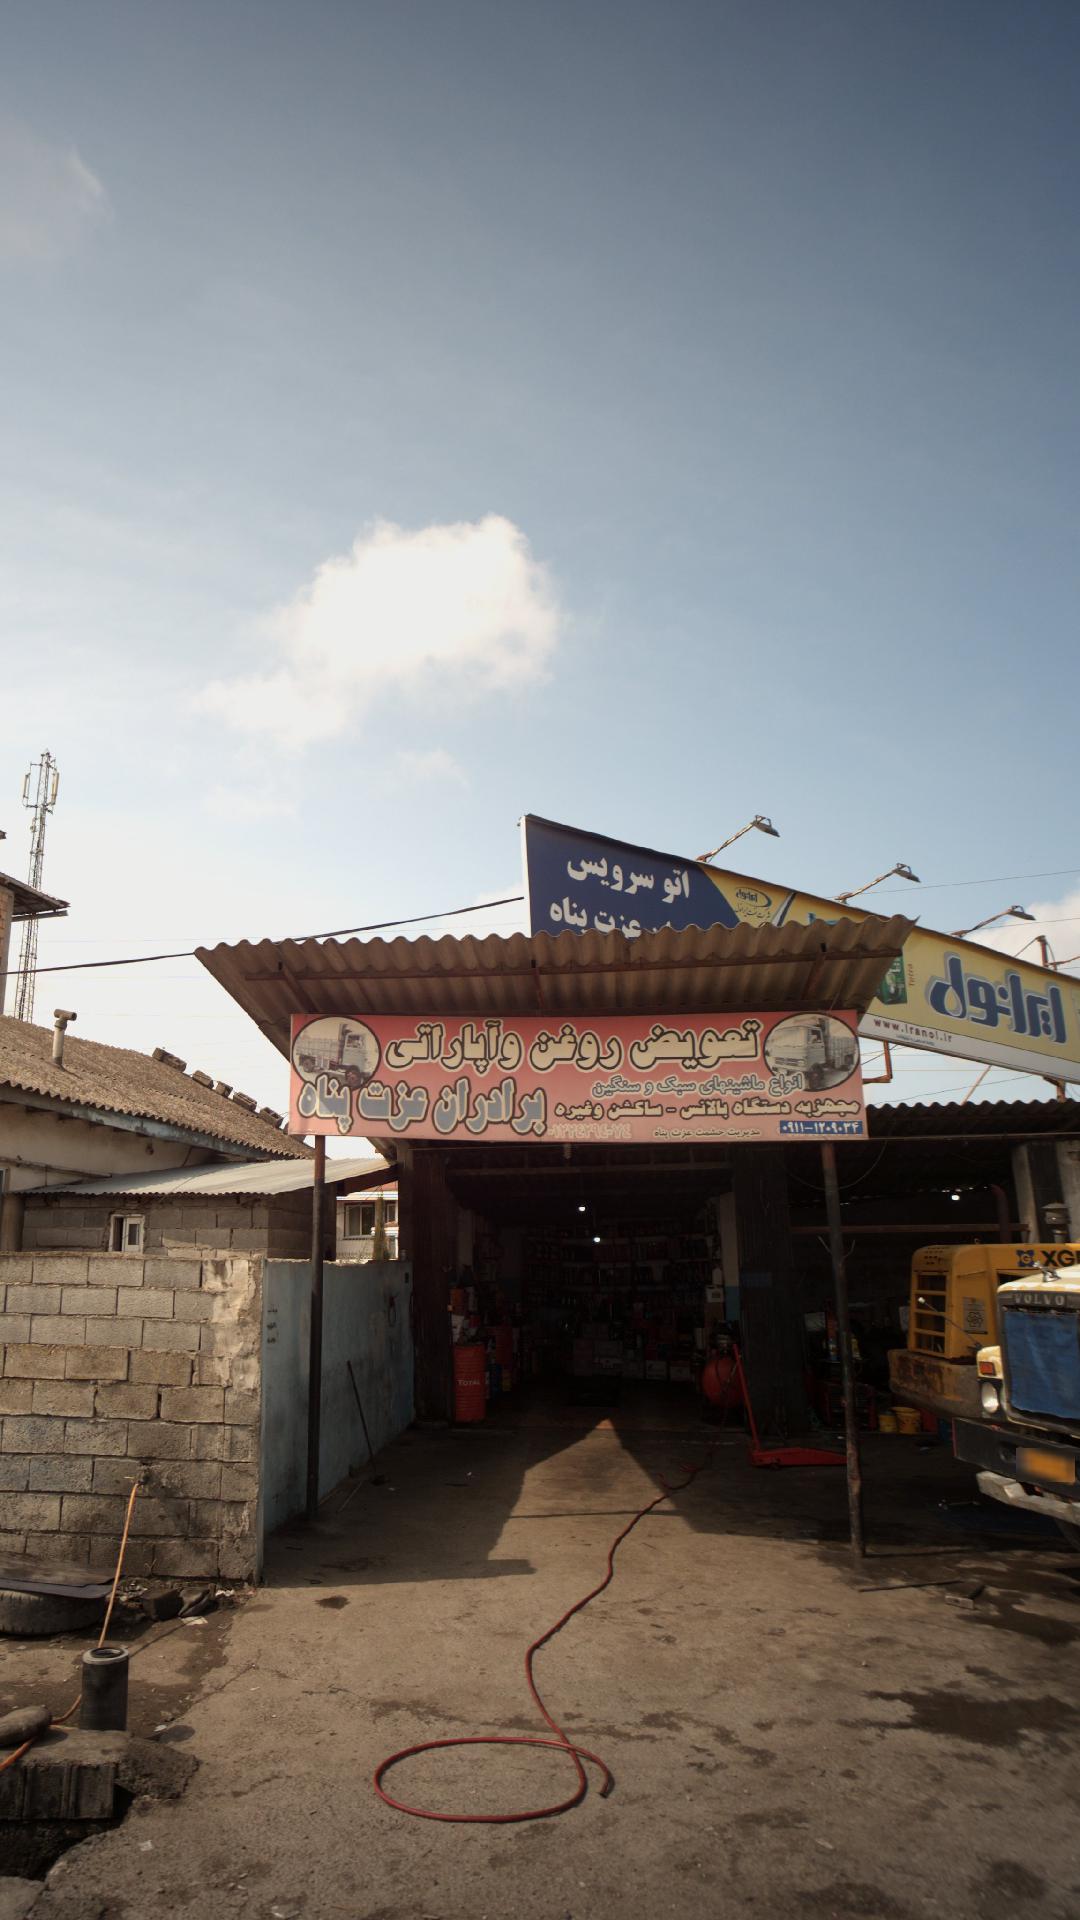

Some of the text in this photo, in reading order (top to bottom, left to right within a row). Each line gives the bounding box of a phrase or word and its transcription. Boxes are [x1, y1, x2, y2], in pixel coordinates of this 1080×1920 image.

[567, 855, 690, 903] اتو سرویس
[928, 955, 1067, 1043] ایرانول
[529, 1023, 622, 1071] روغن
[629, 1019, 762, 1071] تعویض
[592, 1074, 641, 1098] سنگین
[643, 1081, 654, 1096] و
[656, 1075, 696, 1095] سبک
[768, 1073, 805, 1096] انواع
[298, 1072, 547, 1136] برادران عزت پناه
[607, 1099, 663, 1119] ساکشن
[679, 1098, 729, 1120] بالانس
[733, 1098, 791, 1116] دستگاه
[653, 1126, 669, 1139] پناه
[671, 1127, 694, 1139] عزت
[727, 1127, 761, 1138] مدیریت
[1040, 1249, 1080, 1267] XG
[1013, 1292, 1065, 1306] VOLVO
